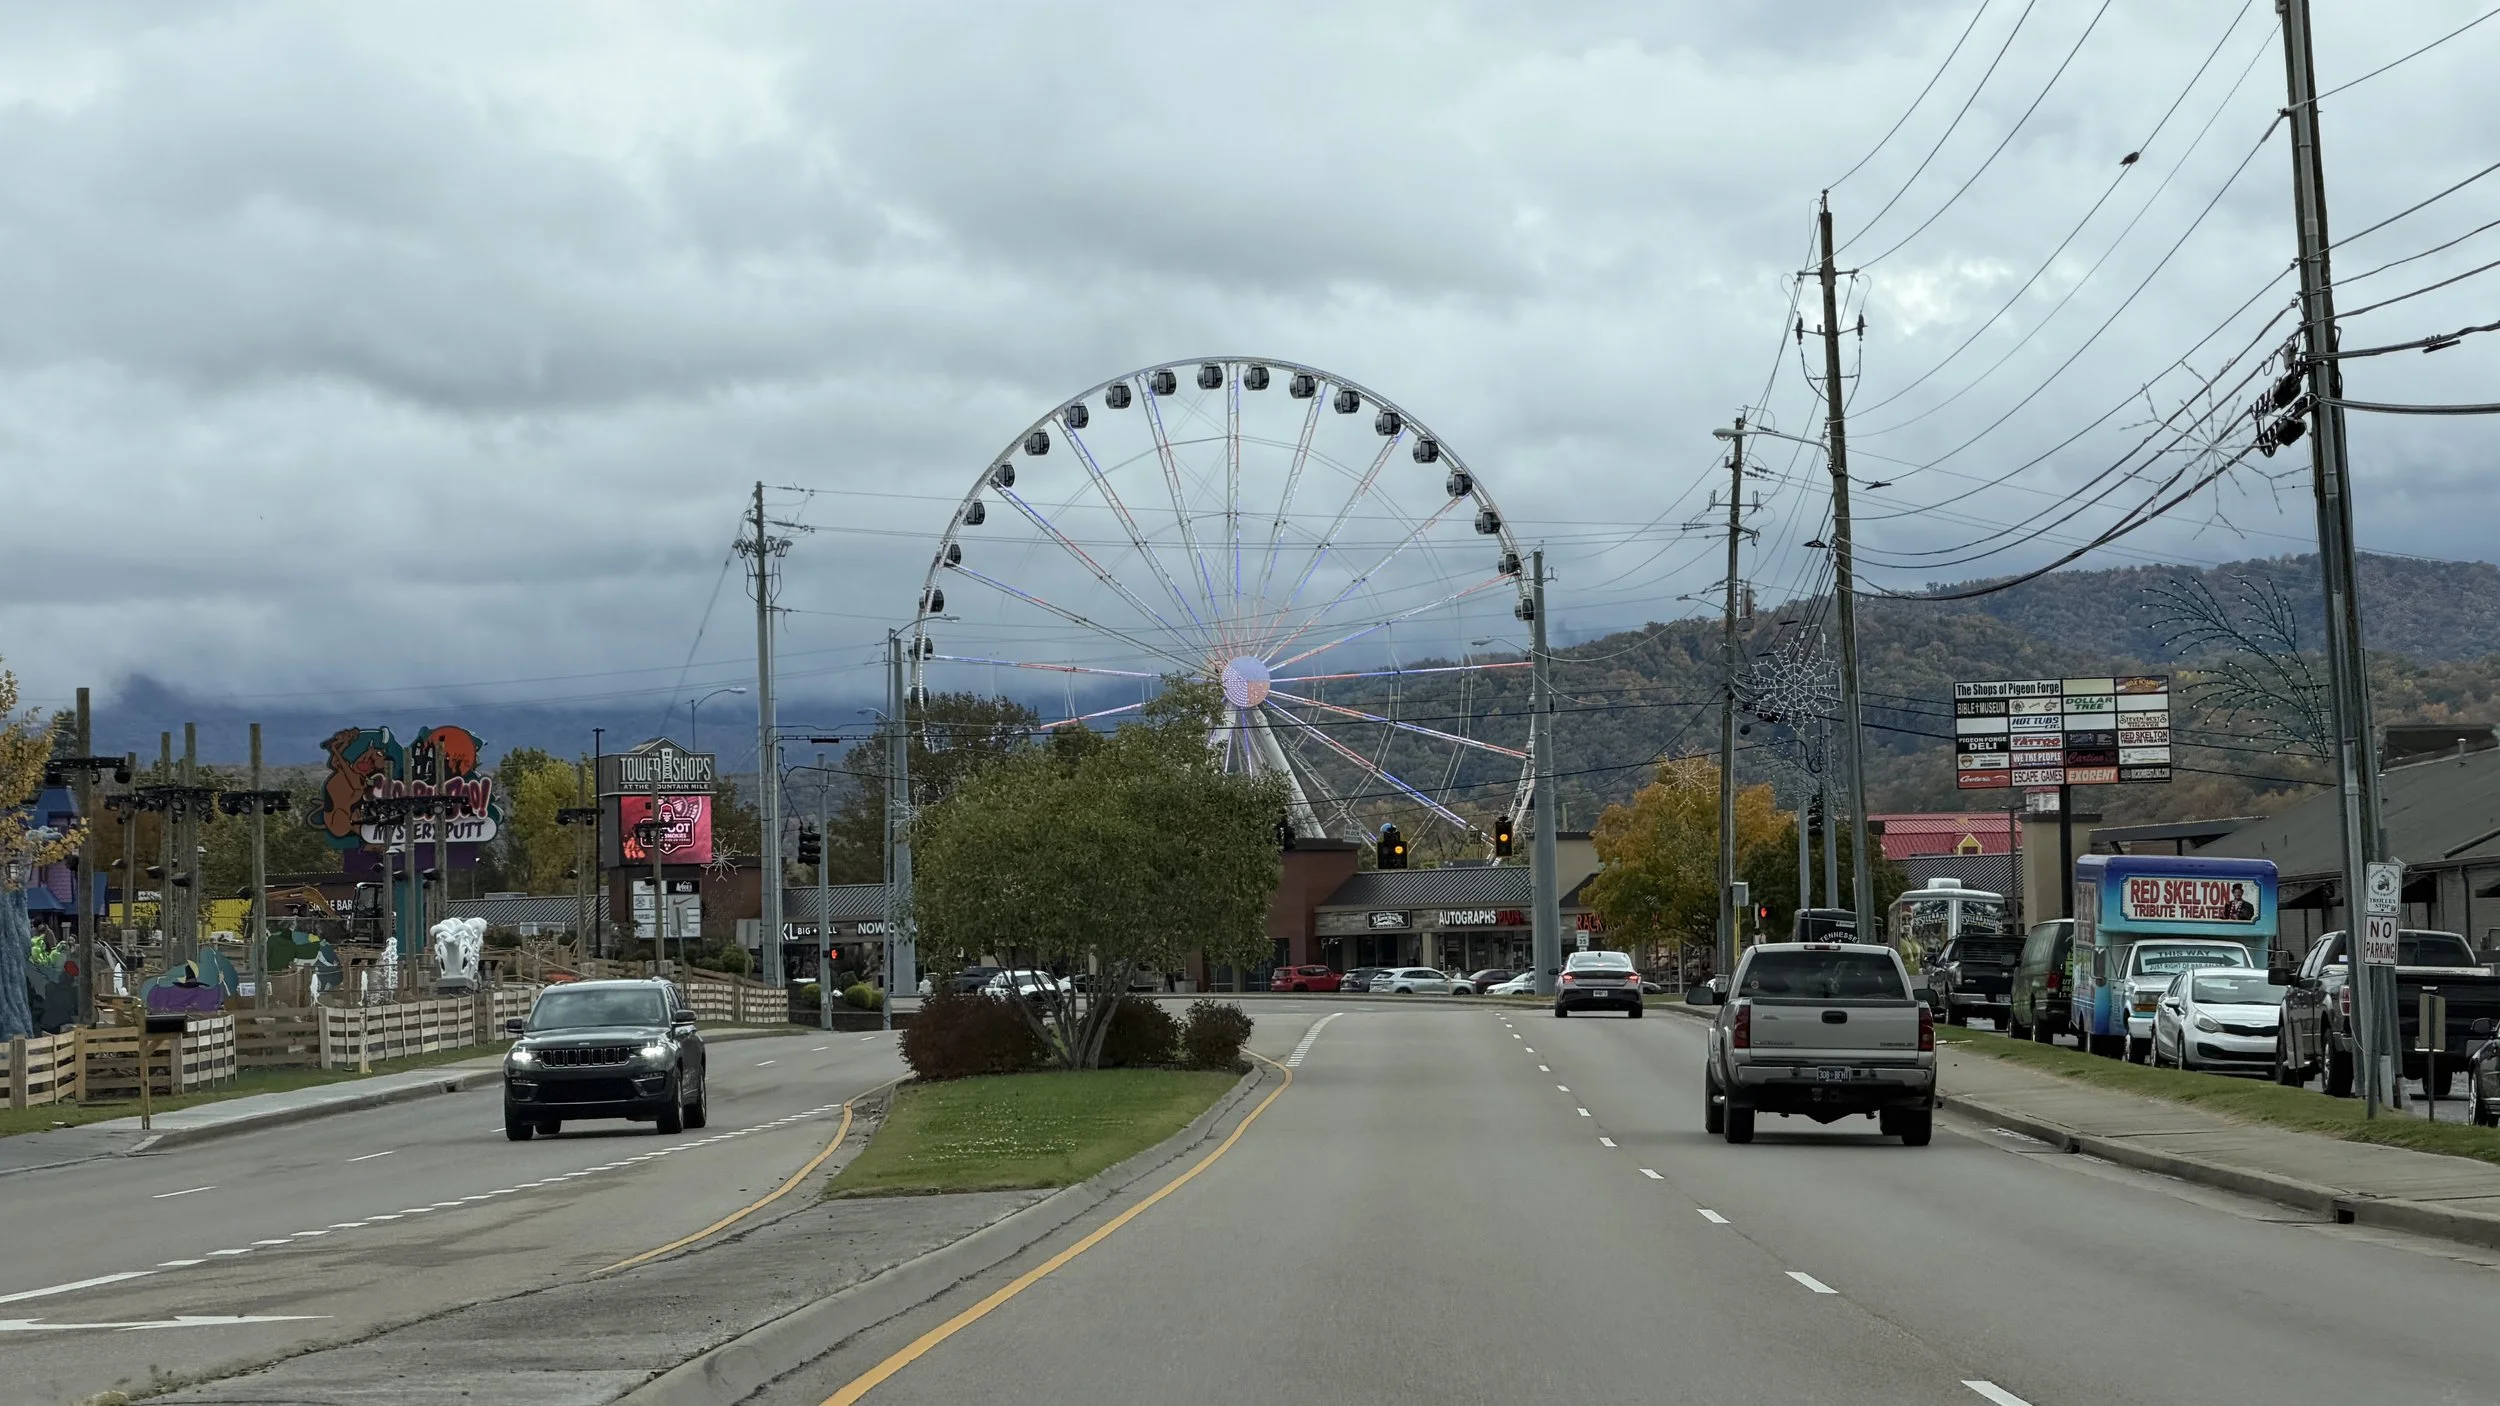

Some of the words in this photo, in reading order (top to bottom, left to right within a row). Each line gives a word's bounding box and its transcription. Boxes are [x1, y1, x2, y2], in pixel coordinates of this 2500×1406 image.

[1957, 684, 1971, 696] The
[1973, 683, 1998, 696] Shops
[1999, 682, 2007, 694] of
[2008, 682, 2036, 695] Pigeon
[2037, 681, 2059, 694] Forge
[2065, 696, 2113, 704] DOLLAR
[1957, 703, 1974, 714] BIBLE
[1979, 701, 2006, 714] MUSEUM
[2135, 731, 2167, 739] SKELTON
[1969, 742, 1997, 751] DELI
[2012, 754, 2024, 762] WE
[2025, 753, 2037, 762] THE
[2038, 752, 2062, 761] PEOPLE
[620, 757, 661, 781] TOWER
[672, 757, 711, 781] SHOPS
[2013, 771, 2039, 783] ESCAPE
[2041, 770, 2063, 781] GAMES
[443, 820, 485, 839] PUTT
[2130, 880, 2160, 903] RED
[2163, 880, 2231, 905] SKELTON
[336, 899, 353, 910] BAR
[1438, 910, 1497, 926] AUTOGRAPHS
[2133, 904, 2176, 918] TRIBUTE
[2180, 905, 2226, 920] THEATER
[797, 926, 811, 935] BIG
[857, 922, 884, 935] NOW
[2370, 921, 2391, 938] NO
[2365, 942, 2394, 959] PARKING
